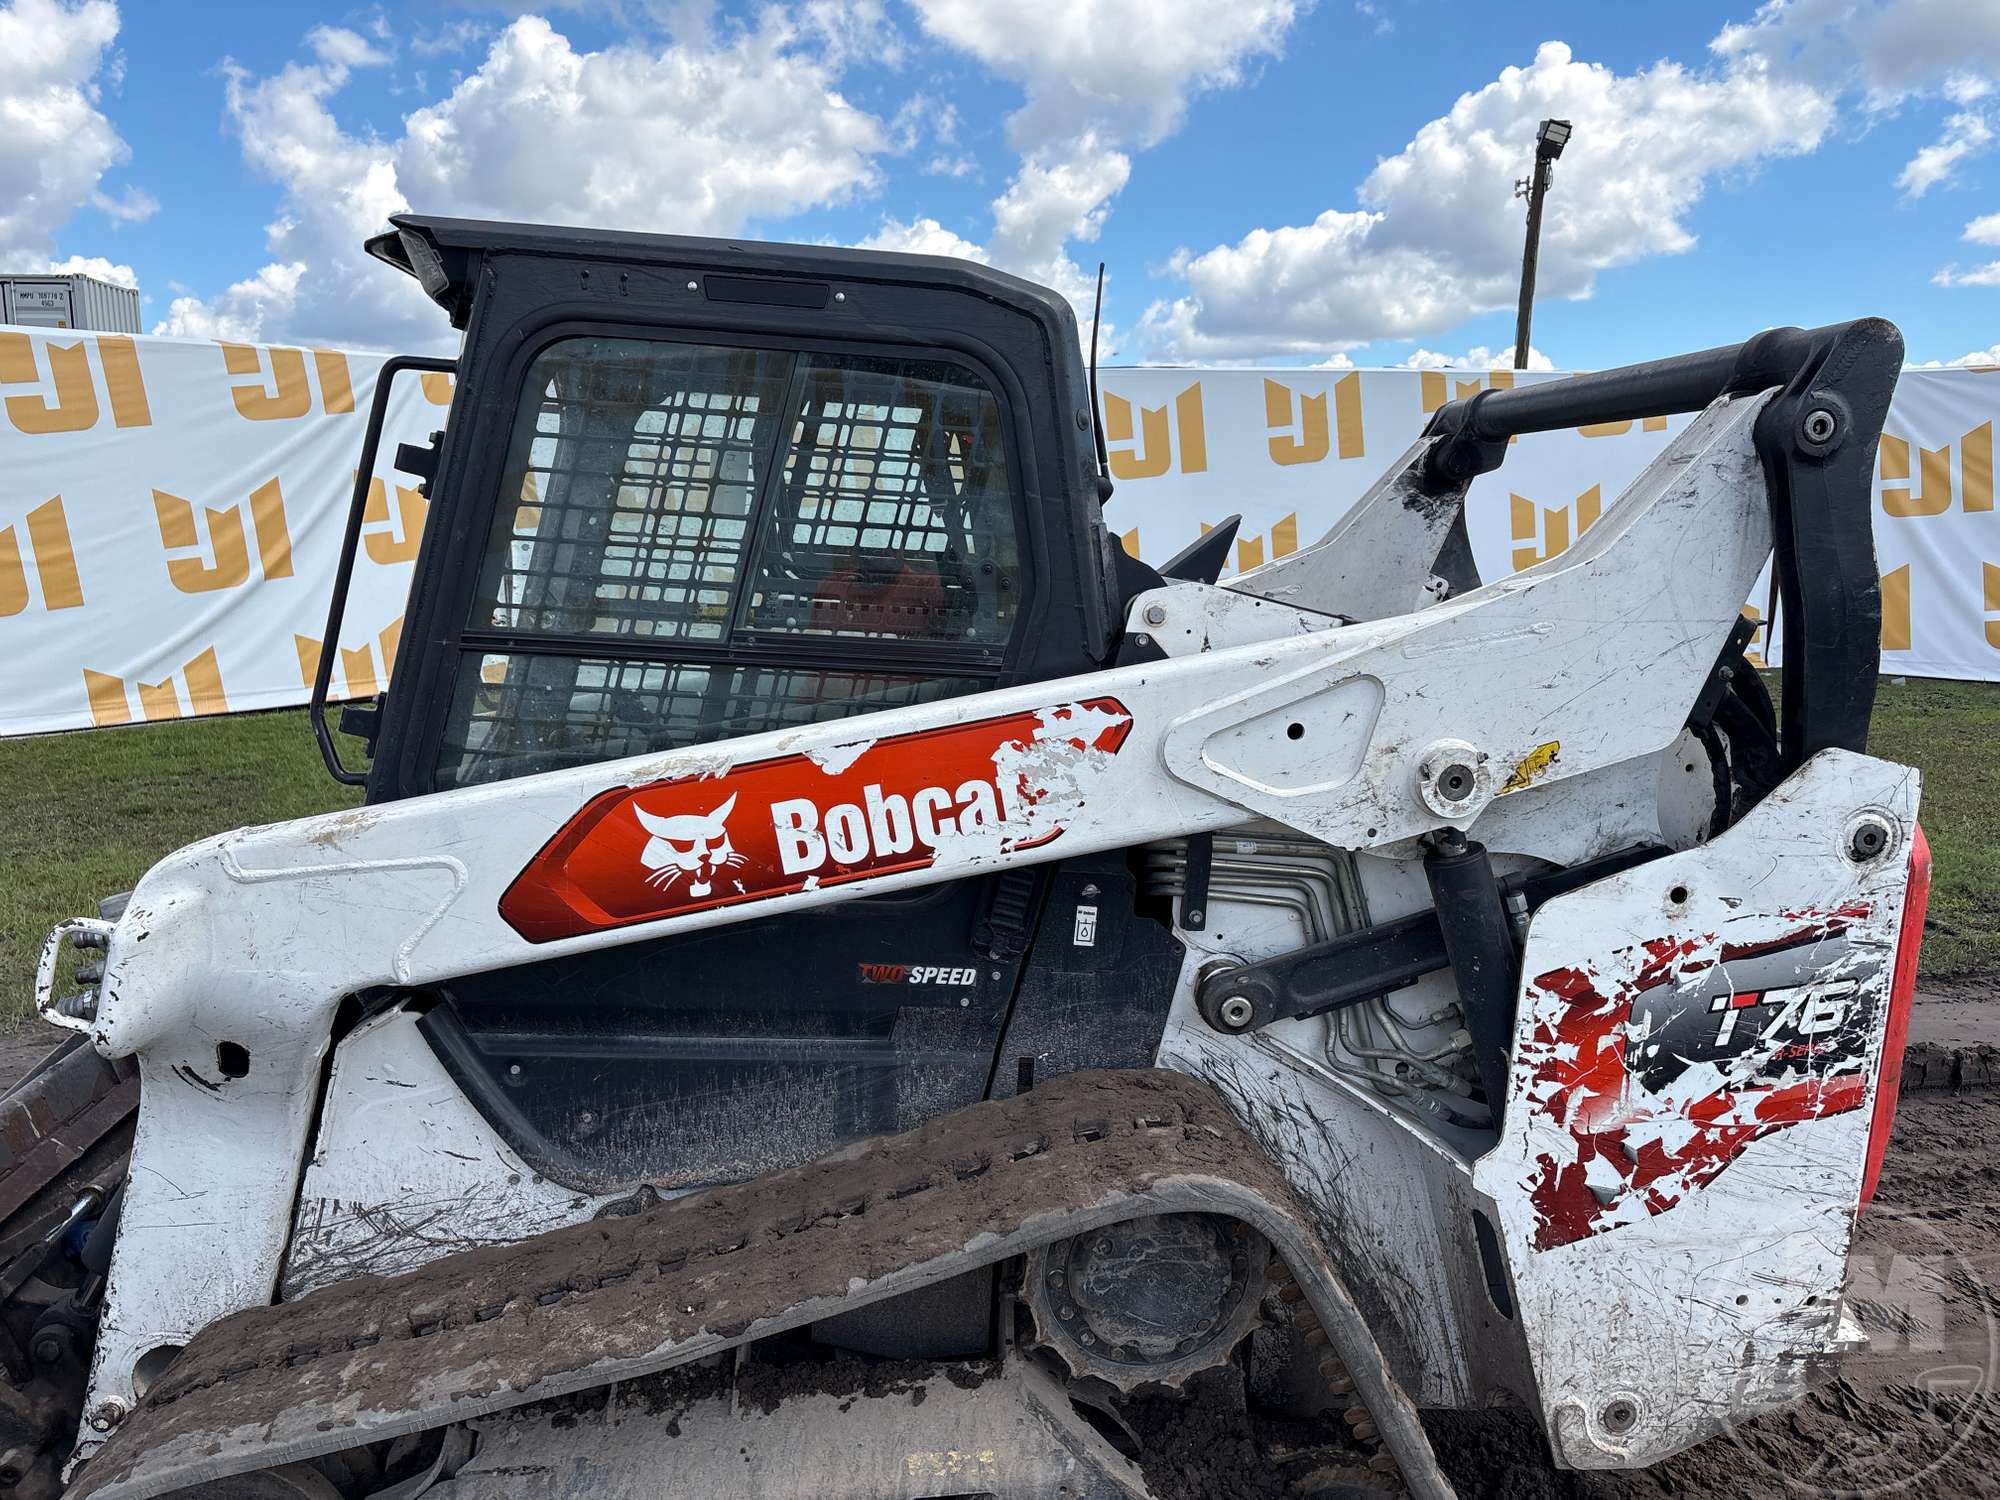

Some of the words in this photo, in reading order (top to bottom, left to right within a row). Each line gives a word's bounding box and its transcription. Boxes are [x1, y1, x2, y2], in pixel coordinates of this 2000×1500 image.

[860, 963, 905, 984] TWO
[908, 966, 977, 986] SPEED
[1710, 979, 1857, 1047] T76
